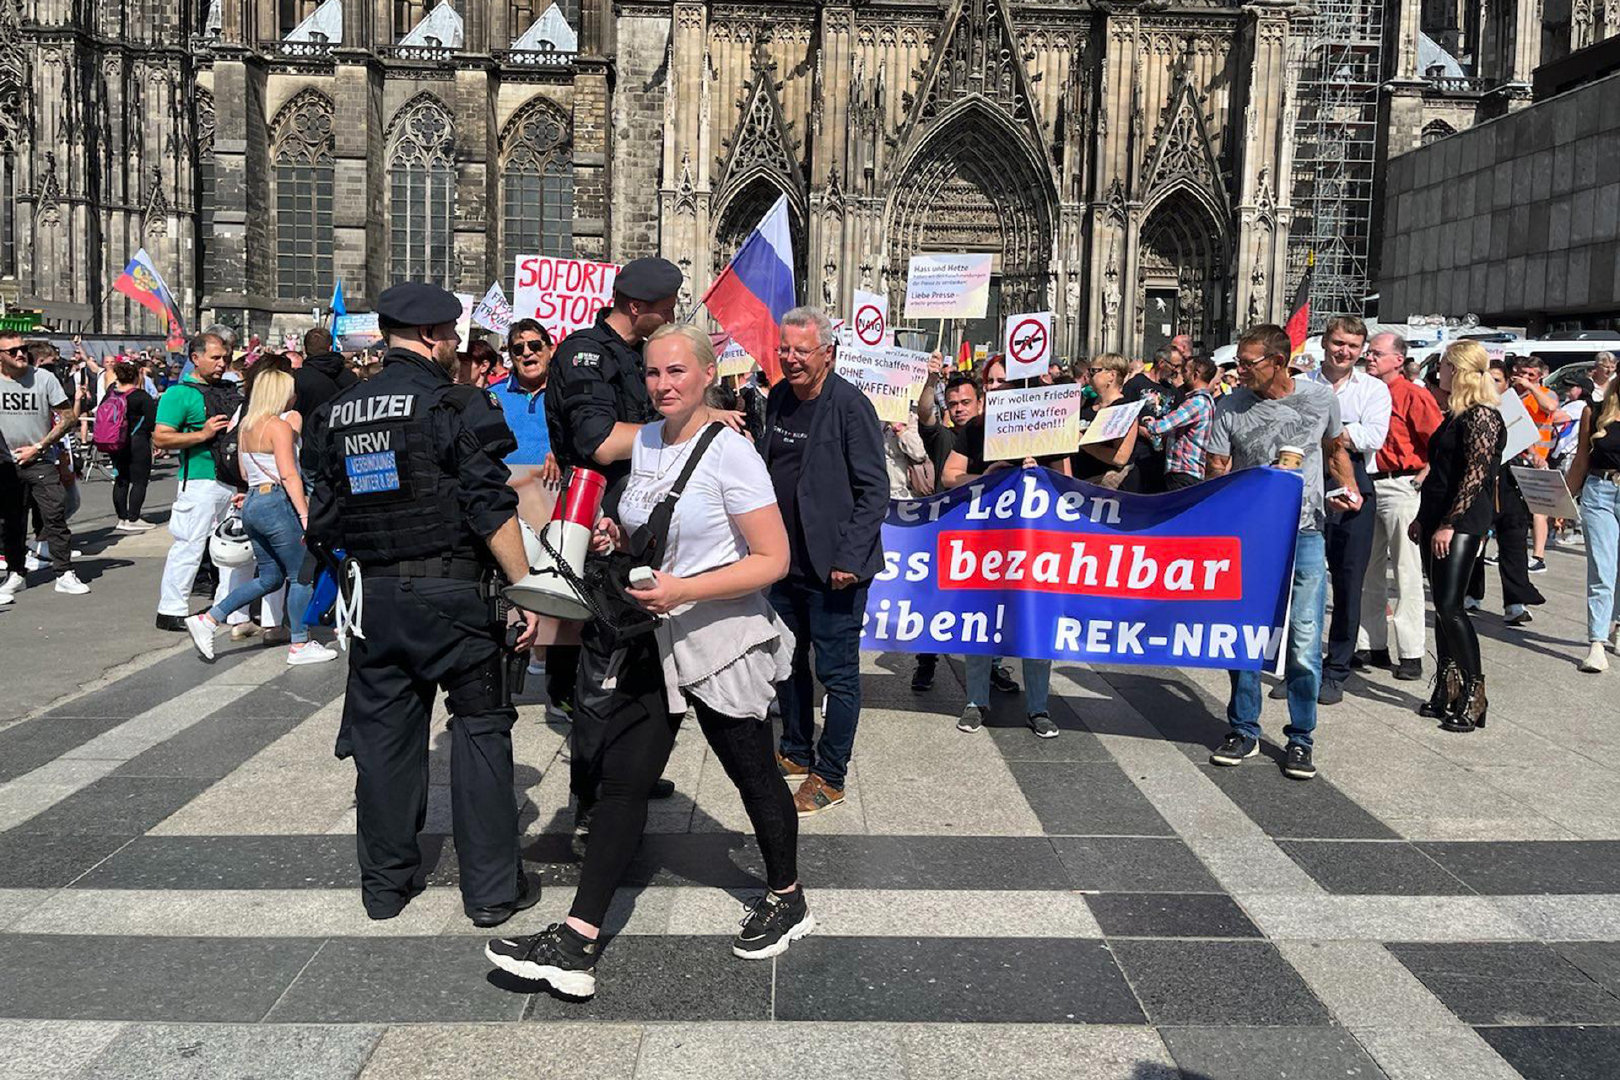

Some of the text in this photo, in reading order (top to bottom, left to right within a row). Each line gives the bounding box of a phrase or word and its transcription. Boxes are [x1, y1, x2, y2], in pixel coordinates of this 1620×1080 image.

[519, 258, 621, 293] SOFORT
[858, 318, 881, 332] NATO
[839, 350, 910, 372] Frieden schaffen
[840, 367, 864, 379] OHNE
[855, 380, 908, 398] WAFFEN!!!
[987, 388, 1081, 406] Wir wollen Frieden
[328, 394, 414, 428] POLIZEI
[996, 406, 1067, 422] KEINE Waffen
[996, 418, 1066, 434] schmieden!!!
[344, 430, 390, 456] NRW
[885, 475, 1122, 524] er Leben
[949, 539, 1230, 591] bezahlbar
[1054, 617, 1284, 660] REK-NRW
